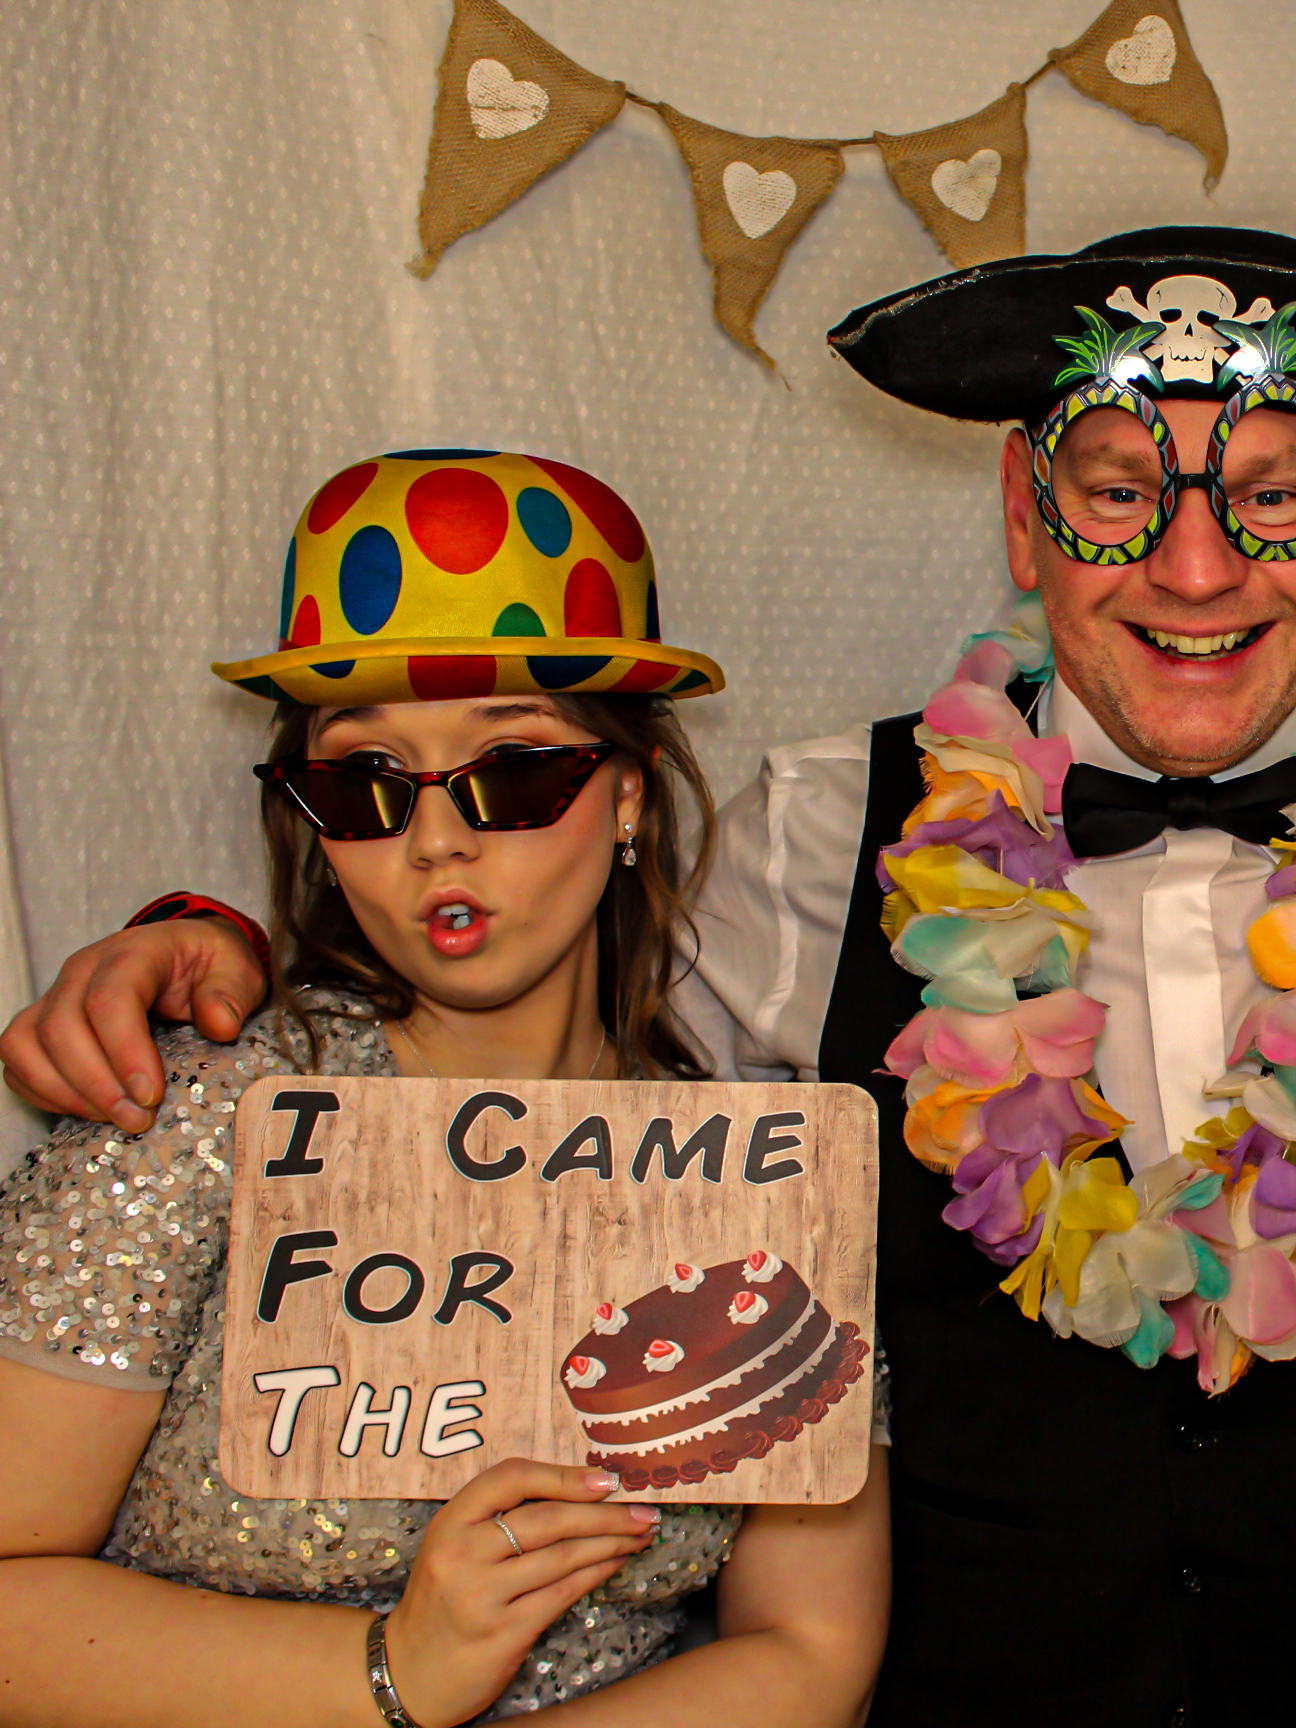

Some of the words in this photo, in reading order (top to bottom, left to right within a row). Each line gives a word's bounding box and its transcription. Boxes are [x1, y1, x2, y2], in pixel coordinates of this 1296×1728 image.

[264, 1090, 341, 1179] I
[447, 1090, 806, 1185] CAME
[256, 1230, 515, 1326] FOR
[253, 1365, 487, 1458] THE
